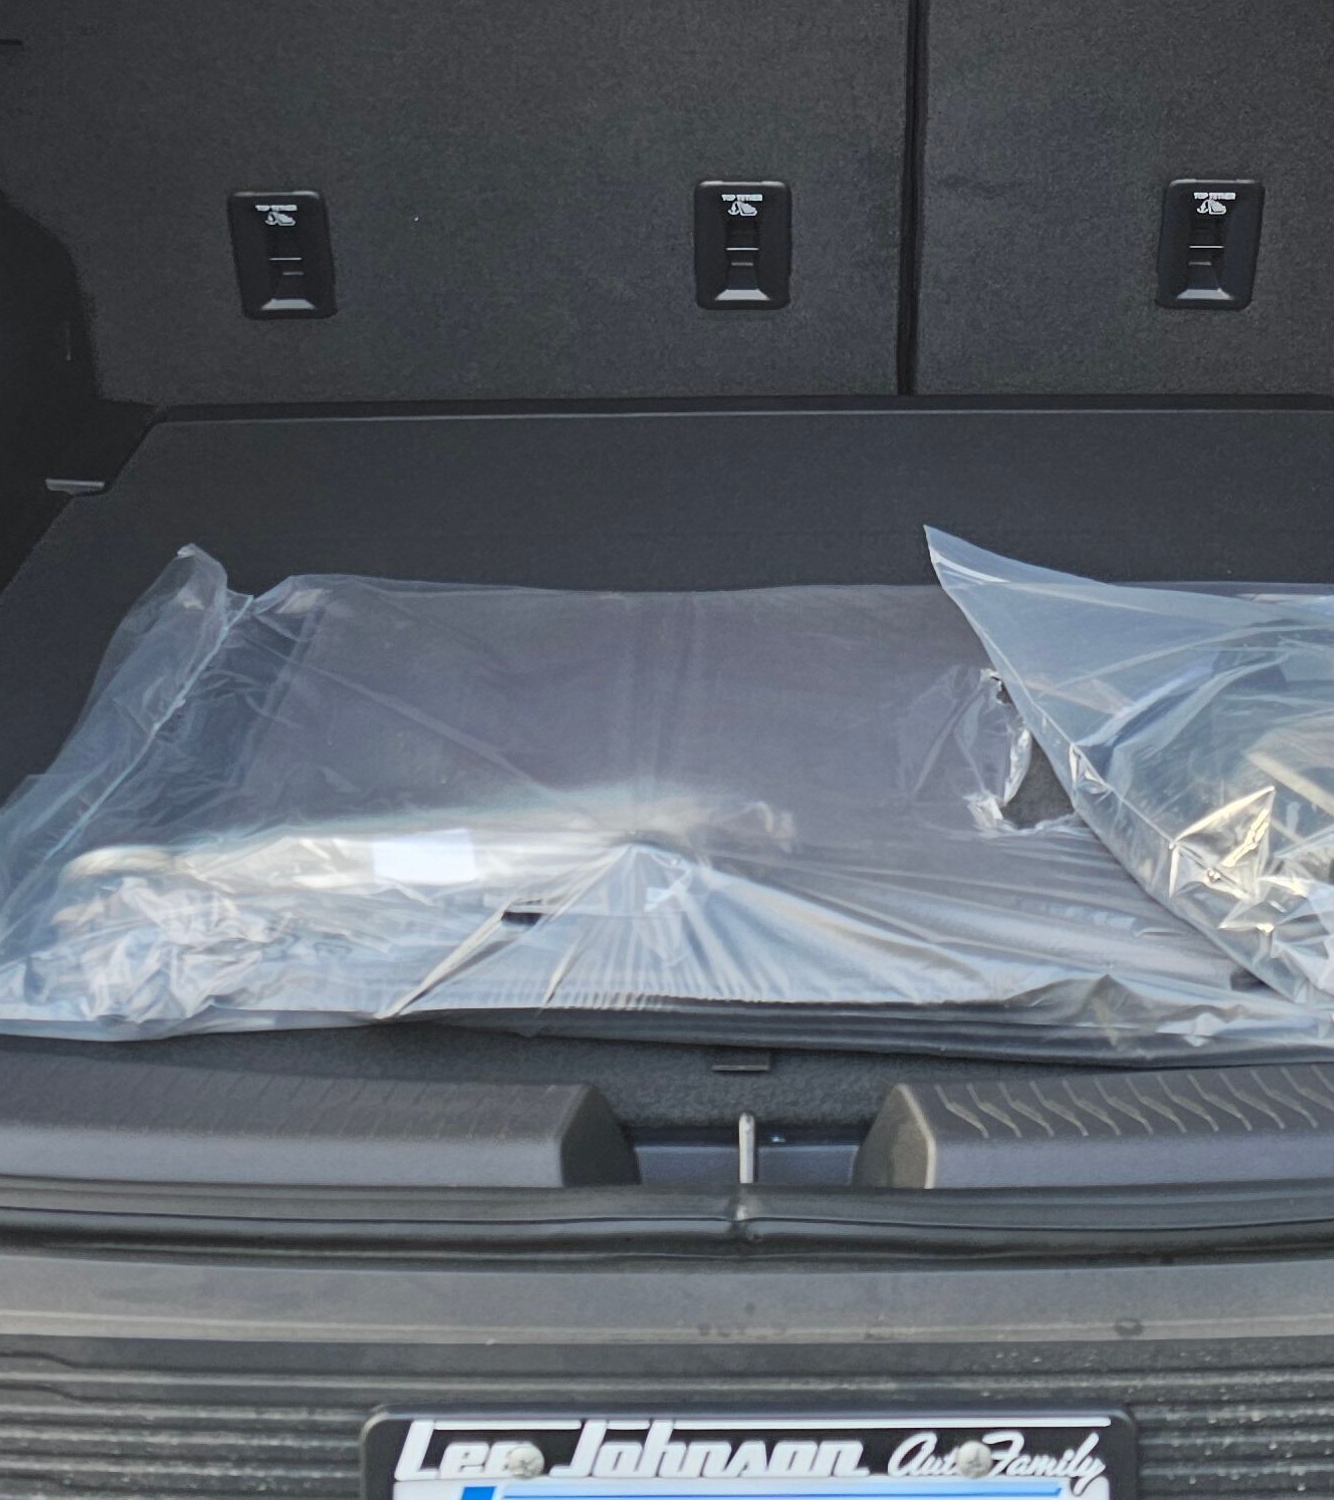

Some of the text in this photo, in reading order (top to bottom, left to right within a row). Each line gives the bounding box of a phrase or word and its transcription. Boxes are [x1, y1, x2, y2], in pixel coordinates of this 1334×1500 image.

[548, 1418, 870, 1478] Johnson
[887, 1431, 979, 1477] Aut
[982, 1430, 1107, 1497] Family
